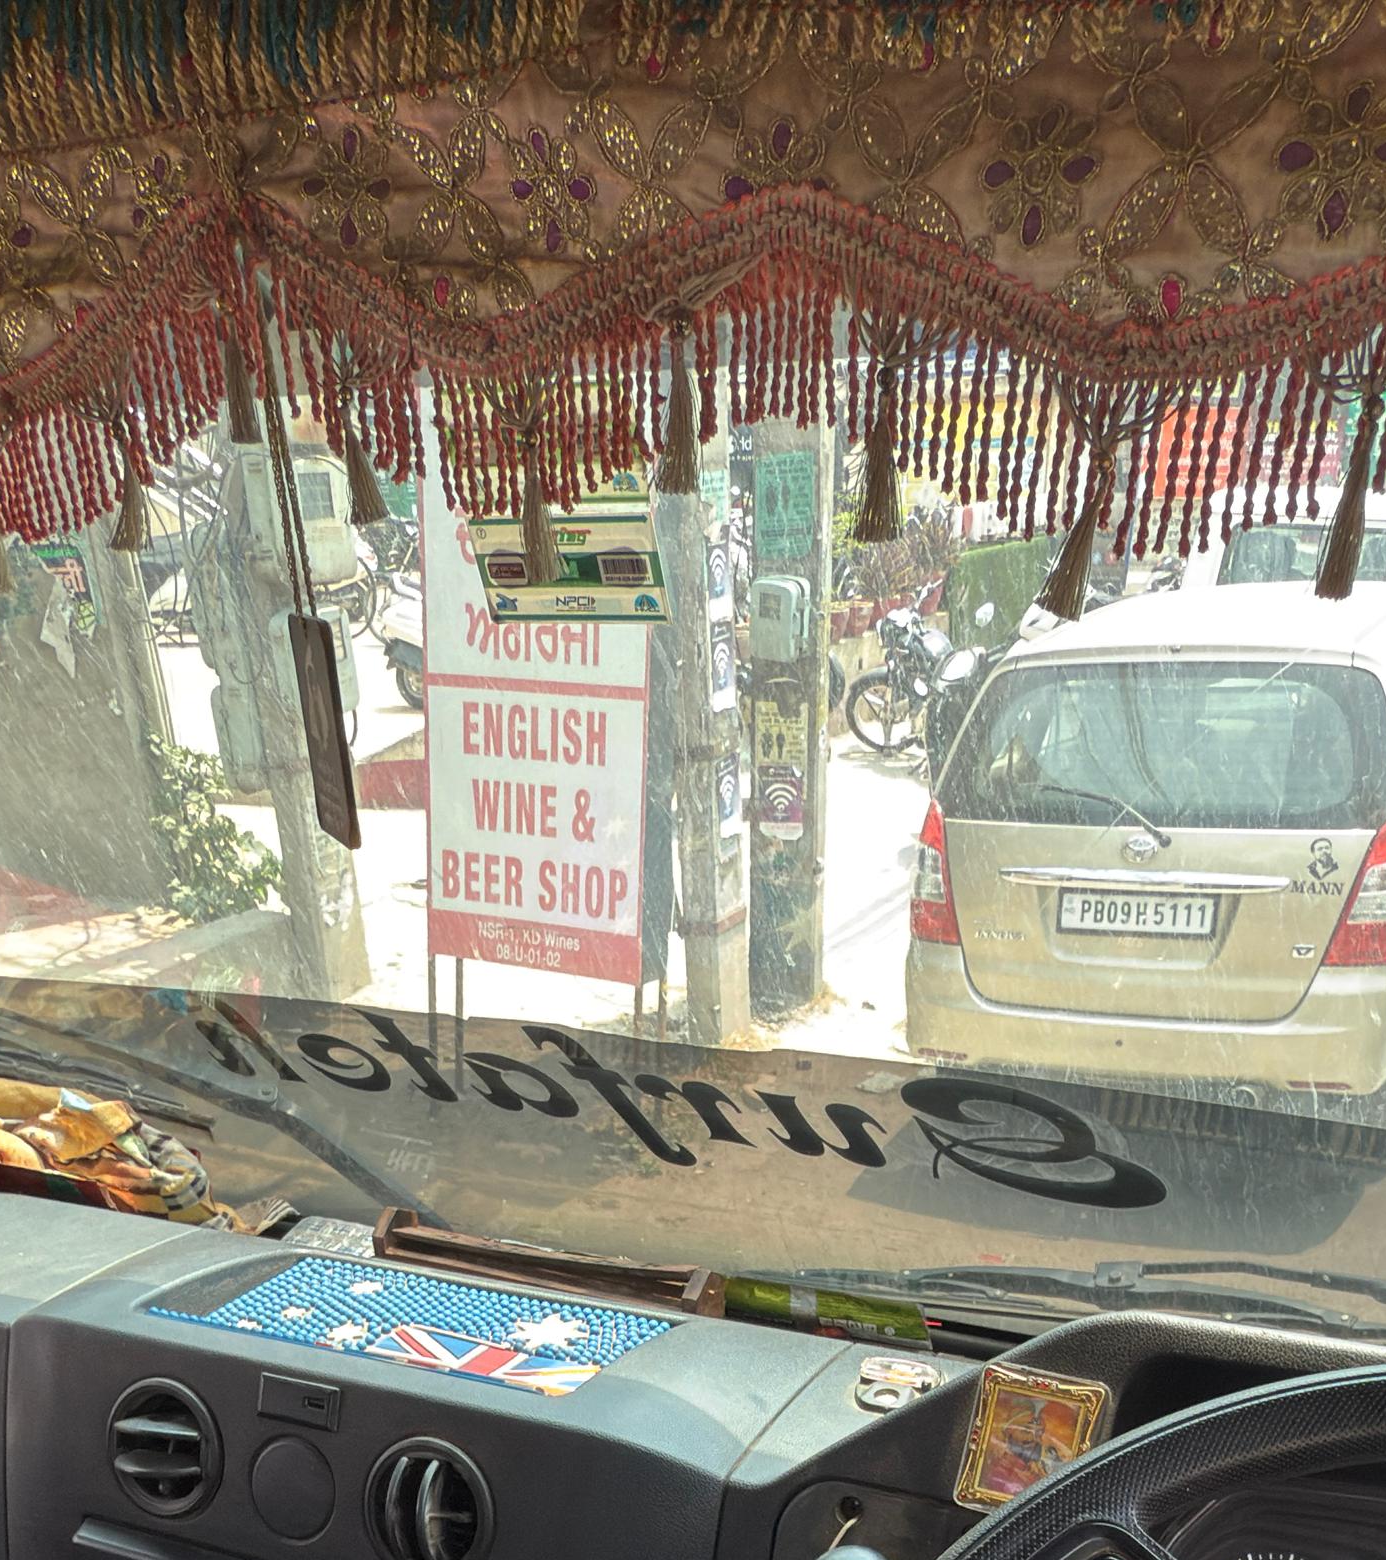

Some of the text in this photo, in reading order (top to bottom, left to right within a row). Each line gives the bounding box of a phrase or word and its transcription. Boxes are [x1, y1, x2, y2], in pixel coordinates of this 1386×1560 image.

[462, 701, 607, 767] ENGLISH
[472, 778, 596, 842] WINE &
[441, 849, 629, 921] BEER SHOP
[1290, 879, 1346, 896] MANN
[544, 929, 581, 952] Wines
